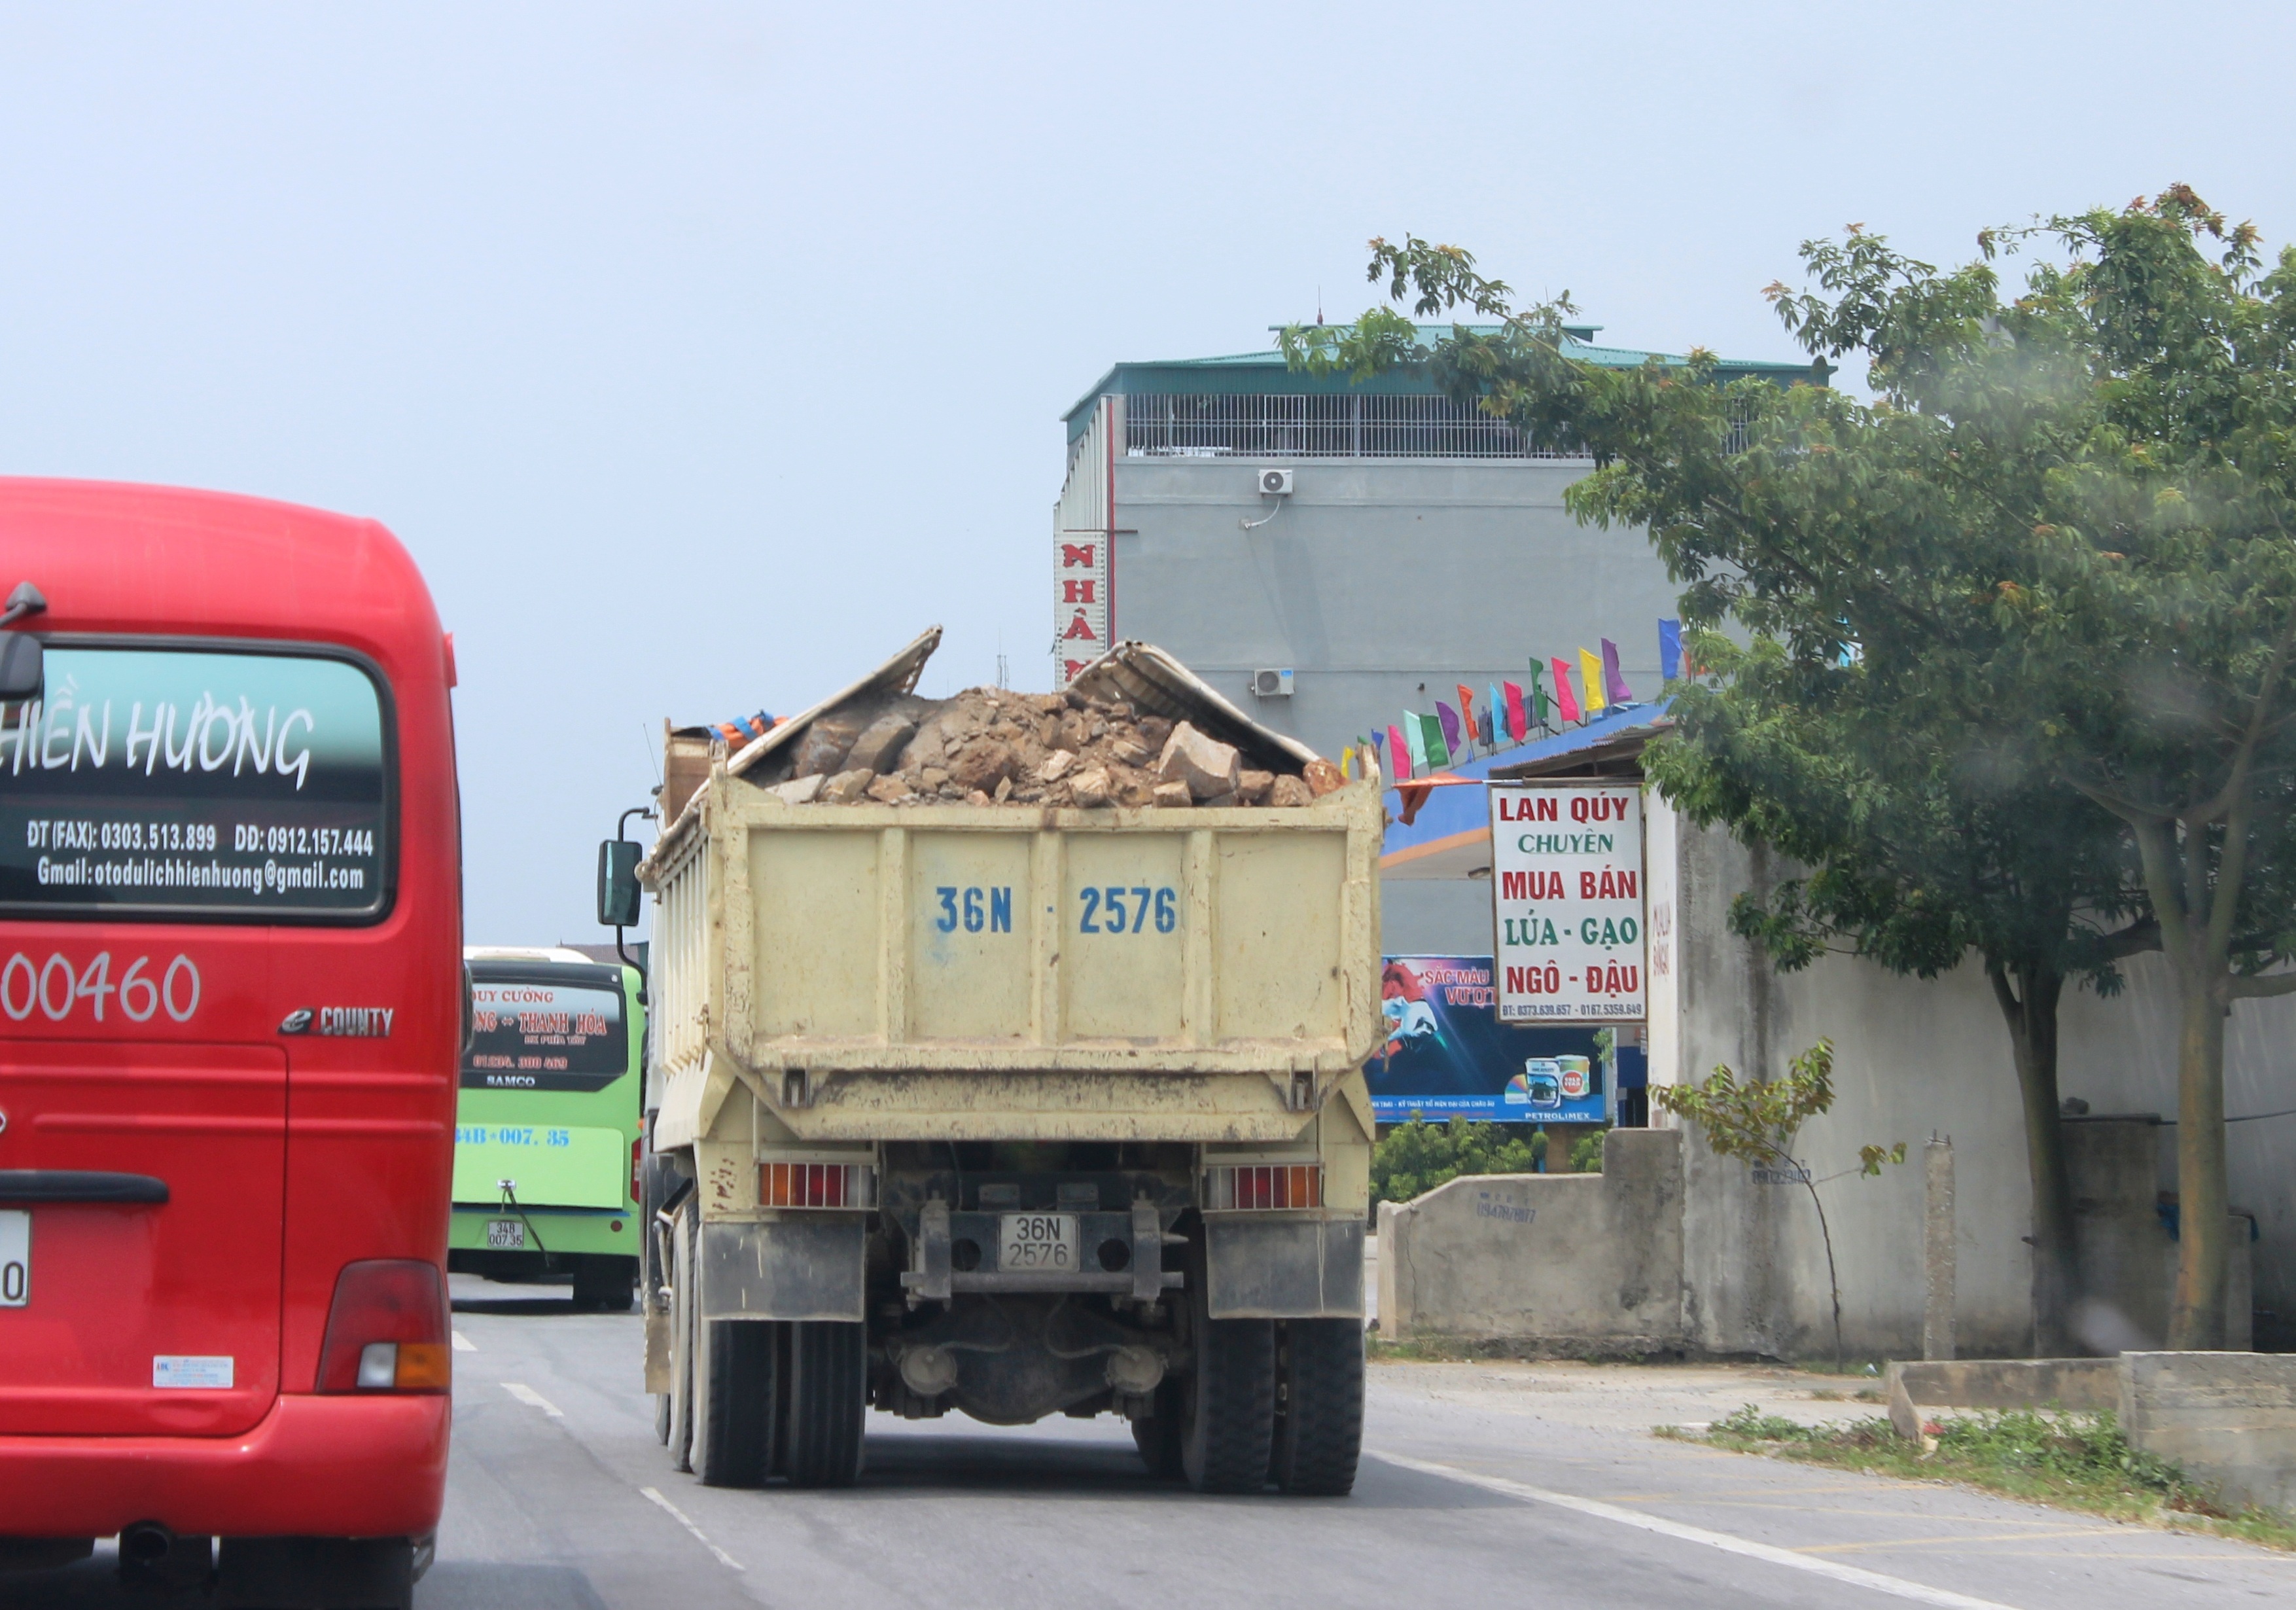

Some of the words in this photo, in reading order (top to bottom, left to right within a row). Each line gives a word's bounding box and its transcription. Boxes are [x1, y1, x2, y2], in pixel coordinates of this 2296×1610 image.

[1500, 798, 1558, 821] LAN
[1570, 791, 1629, 824] QÚY
[101, 822, 217, 851] 0303.513.899
[267, 826, 374, 857] 0912.157.444
[1518, 828, 1614, 853] CHUYÊN
[1502, 871, 1565, 900] MUA
[1580, 865, 1637, 900] BÁN
[936, 886, 1011, 933] 36N
[1080, 886, 1176, 934] 2576
[1504, 908, 1559, 946] LÚA
[1580, 917, 1638, 950] GẠO
[0, 952, 200, 1022] 00460
[1424, 963, 1453, 985] SẮC
[1456, 966, 1490, 985] MÀU
[1507, 959, 1561, 994] NGÔ
[1585, 959, 1638, 998] ĐẬU
[502, 986, 554, 1003] CƯỜNG
[321, 1006, 394, 1037] COUNTY
[518, 1011, 569, 1035] THANH
[576, 1008, 607, 1036] HÓA
[497, 1223, 515, 1234] 34B
[1016, 1217, 1061, 1241] 36N
[1009, 1243, 1069, 1266] 2576
